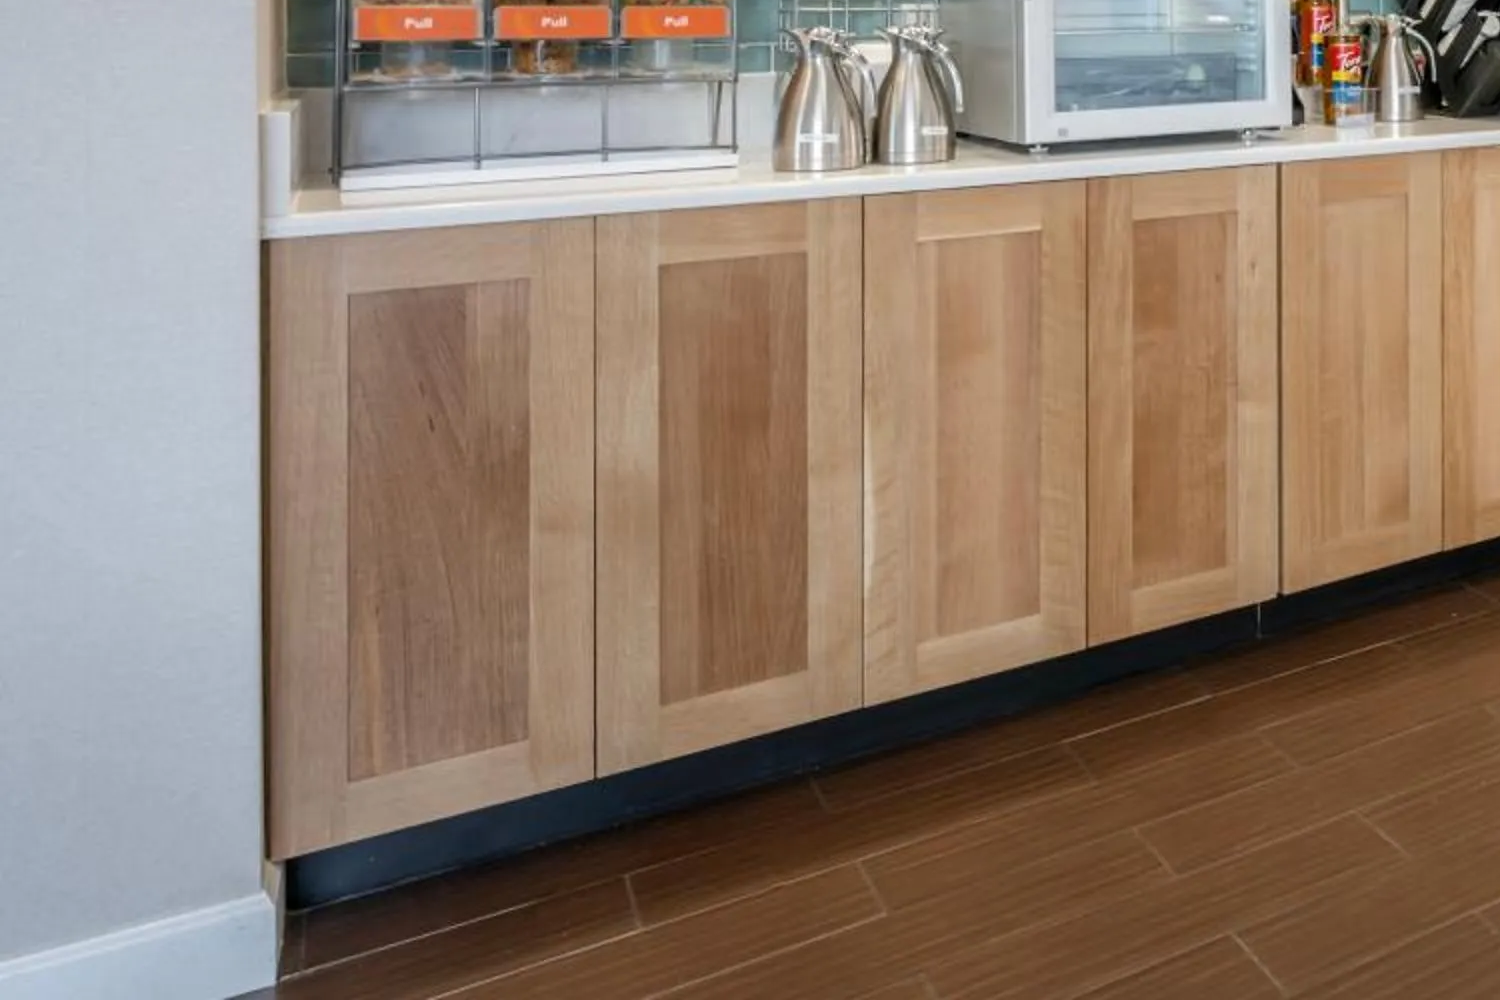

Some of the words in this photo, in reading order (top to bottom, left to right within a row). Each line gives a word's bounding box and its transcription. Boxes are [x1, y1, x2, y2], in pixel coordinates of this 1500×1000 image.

[403, 16, 434, 30] Pull
[541, 15, 568, 28] Pull
[663, 15, 689, 28] Pull
